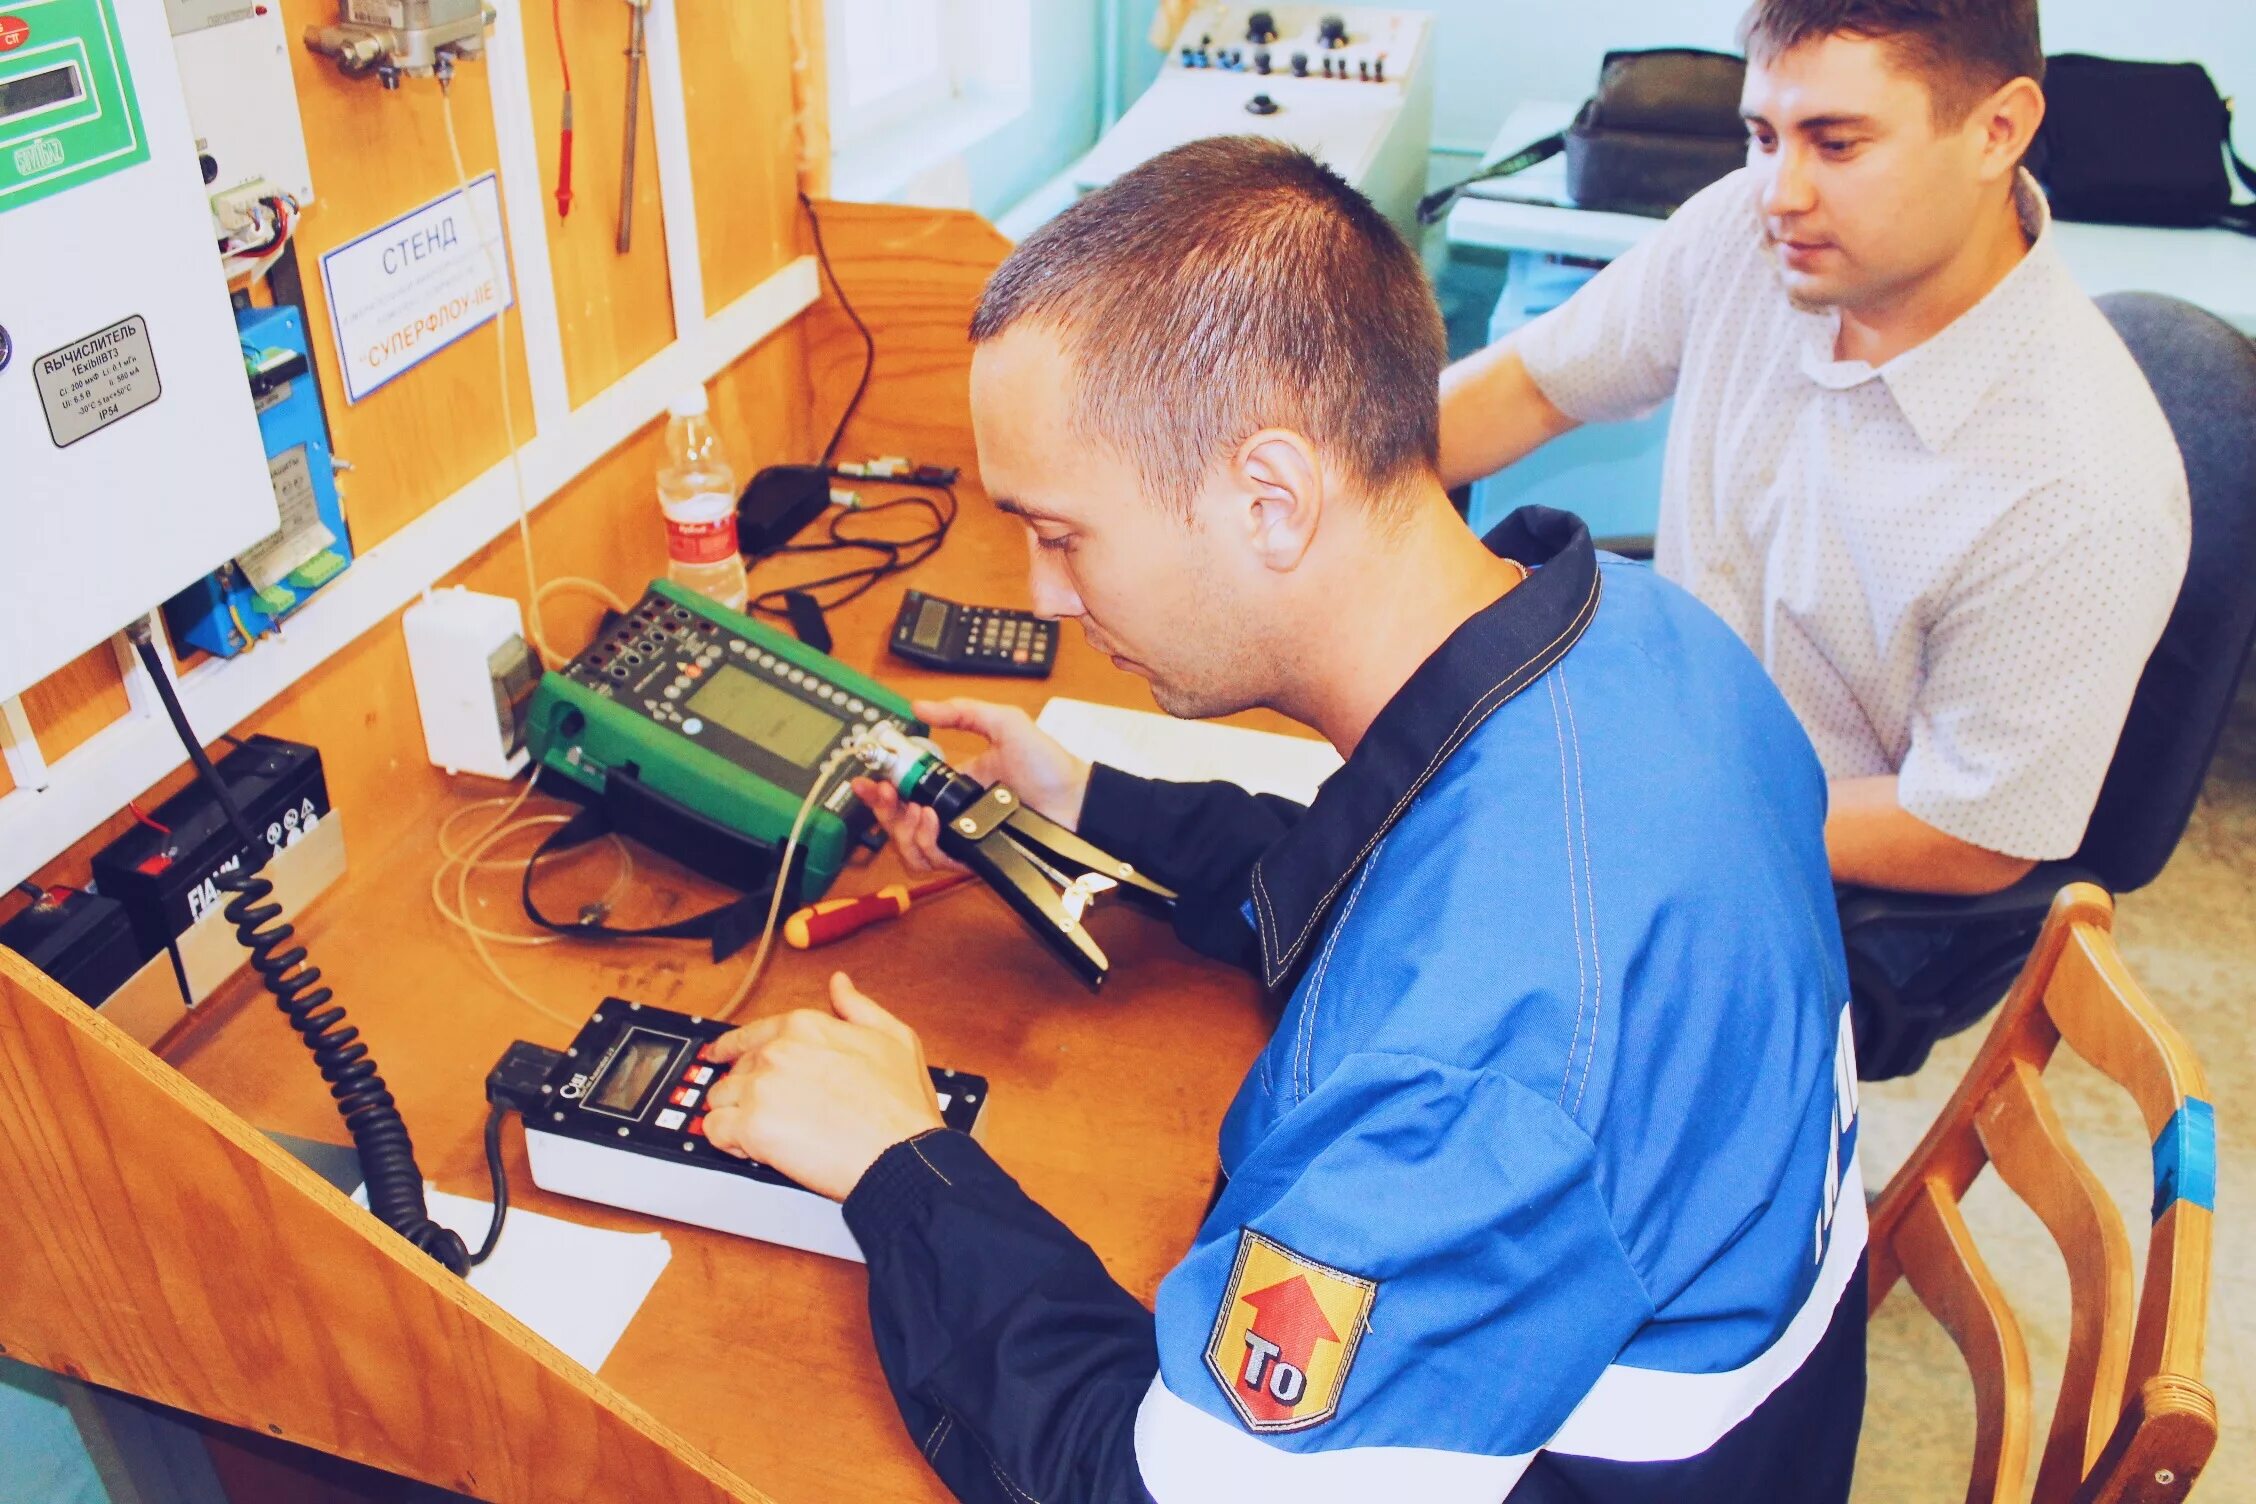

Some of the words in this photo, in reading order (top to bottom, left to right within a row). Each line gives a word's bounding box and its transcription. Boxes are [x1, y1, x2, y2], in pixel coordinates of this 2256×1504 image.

[382, 216, 457, 275] СТЕНД
[43, 324, 136, 374] ВЫЧИСЛИТЕЛЬ
[71, 380, 83, 391] 200
[98, 404, 119, 421] IP54
